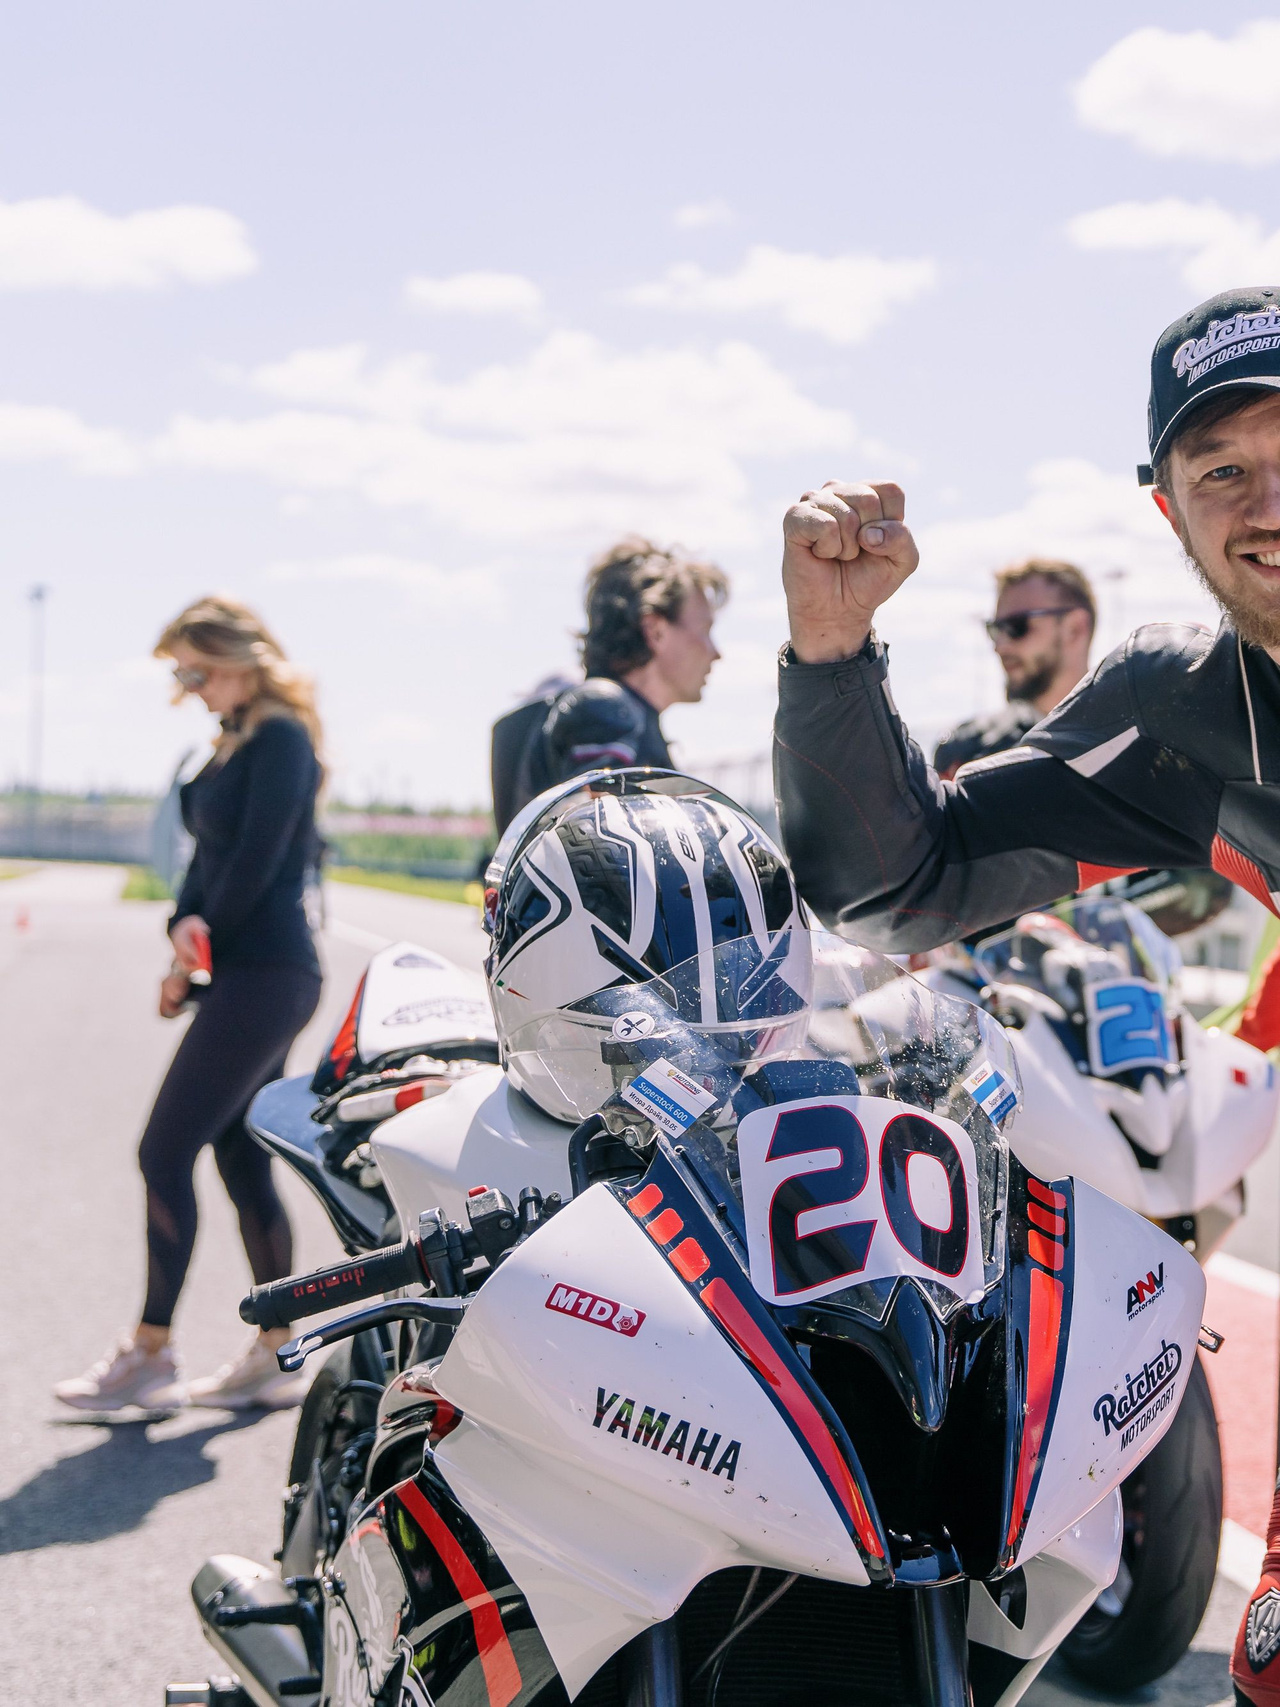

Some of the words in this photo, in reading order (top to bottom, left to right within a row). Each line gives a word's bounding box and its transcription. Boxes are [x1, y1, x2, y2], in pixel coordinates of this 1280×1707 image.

[638, 1081, 675, 1112] Superstock
[673, 1106, 689, 1122] 600
[674, 1073, 702, 1095] MOTORING
[628, 1091, 646, 1108] Игора
[644, 1104, 663, 1121] Драйв
[662, 1118, 678, 1132] 30.05
[764, 1104, 970, 1297] 20
[1126, 1261, 1164, 1315] ANV
[1127, 1286, 1165, 1322] motorsport
[1093, 1339, 1182, 1437] Ratchet
[592, 1386, 742, 1482] YAMAHA
[1120, 1382, 1176, 1452] MOTORSPORT
